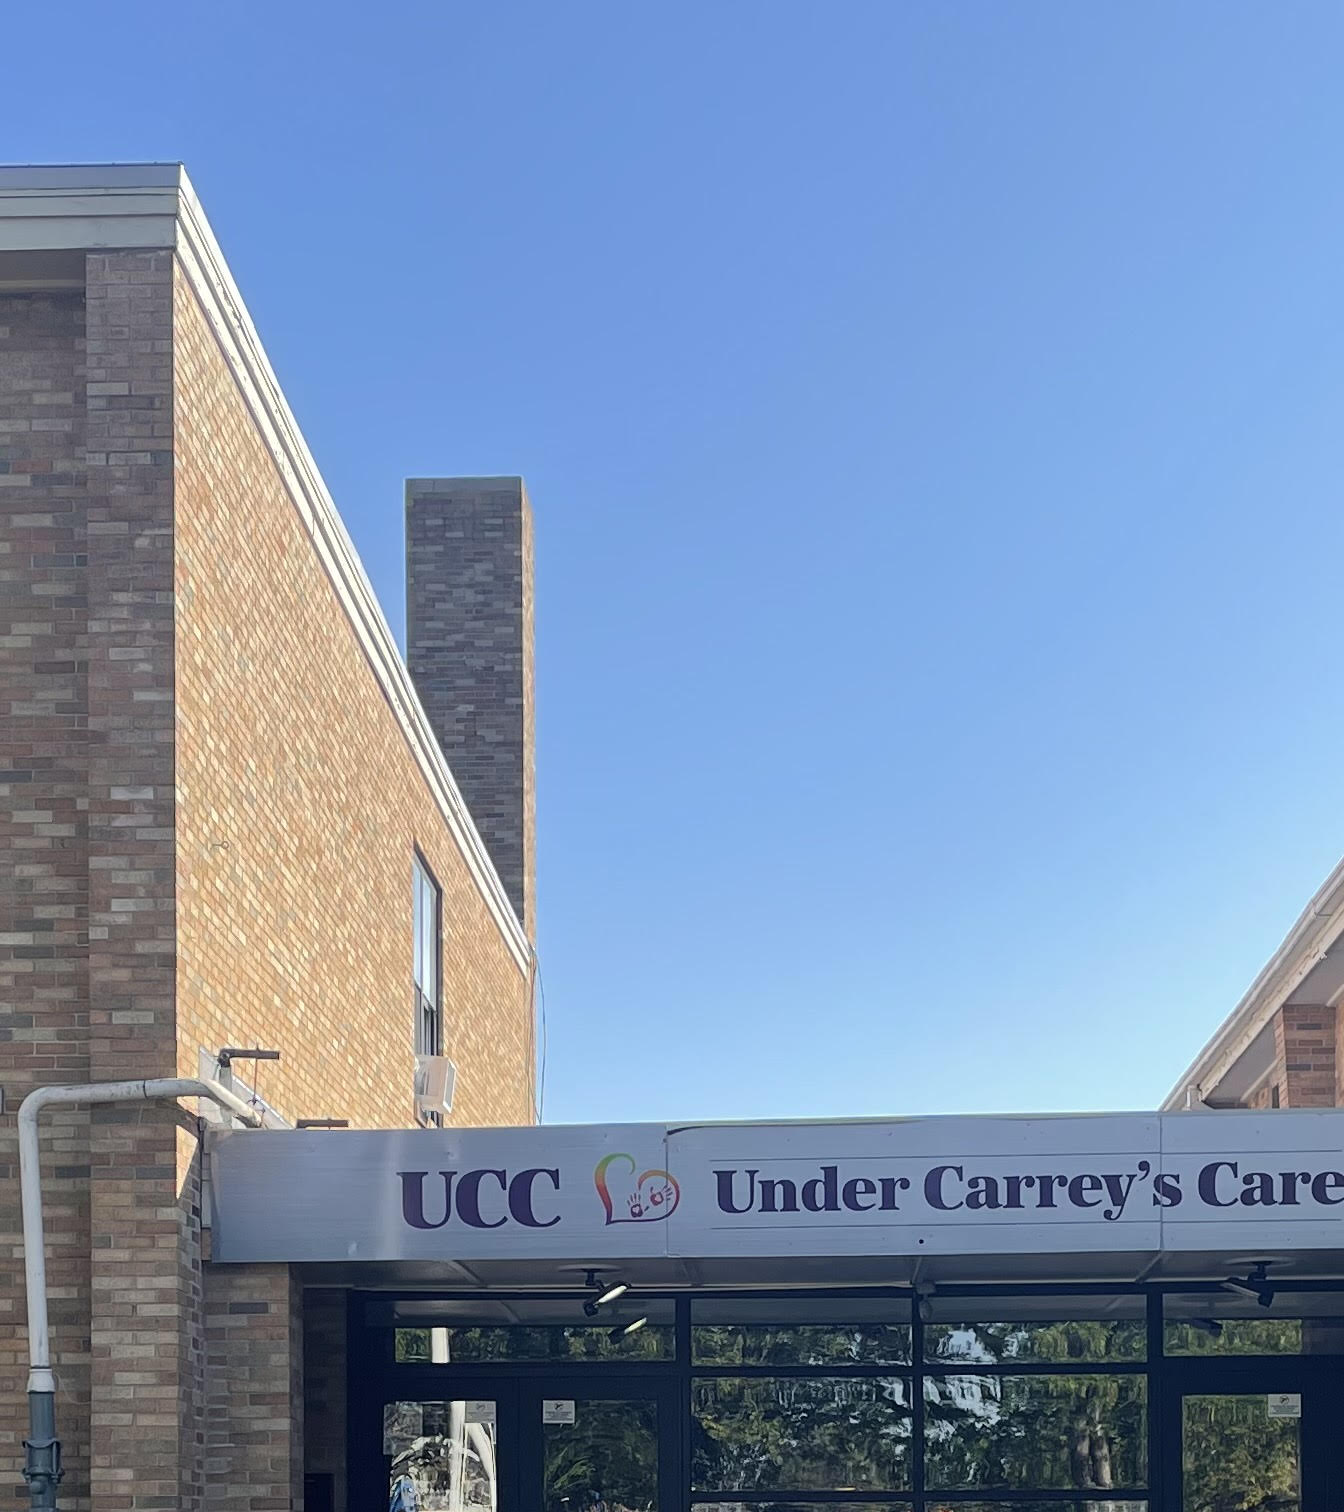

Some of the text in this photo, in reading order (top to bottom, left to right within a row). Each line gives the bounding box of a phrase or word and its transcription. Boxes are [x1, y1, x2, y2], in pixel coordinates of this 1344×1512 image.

[396, 1167, 562, 1231] UCC
[713, 1164, 912, 1215] Under
[923, 1160, 1184, 1221] Carrey's
